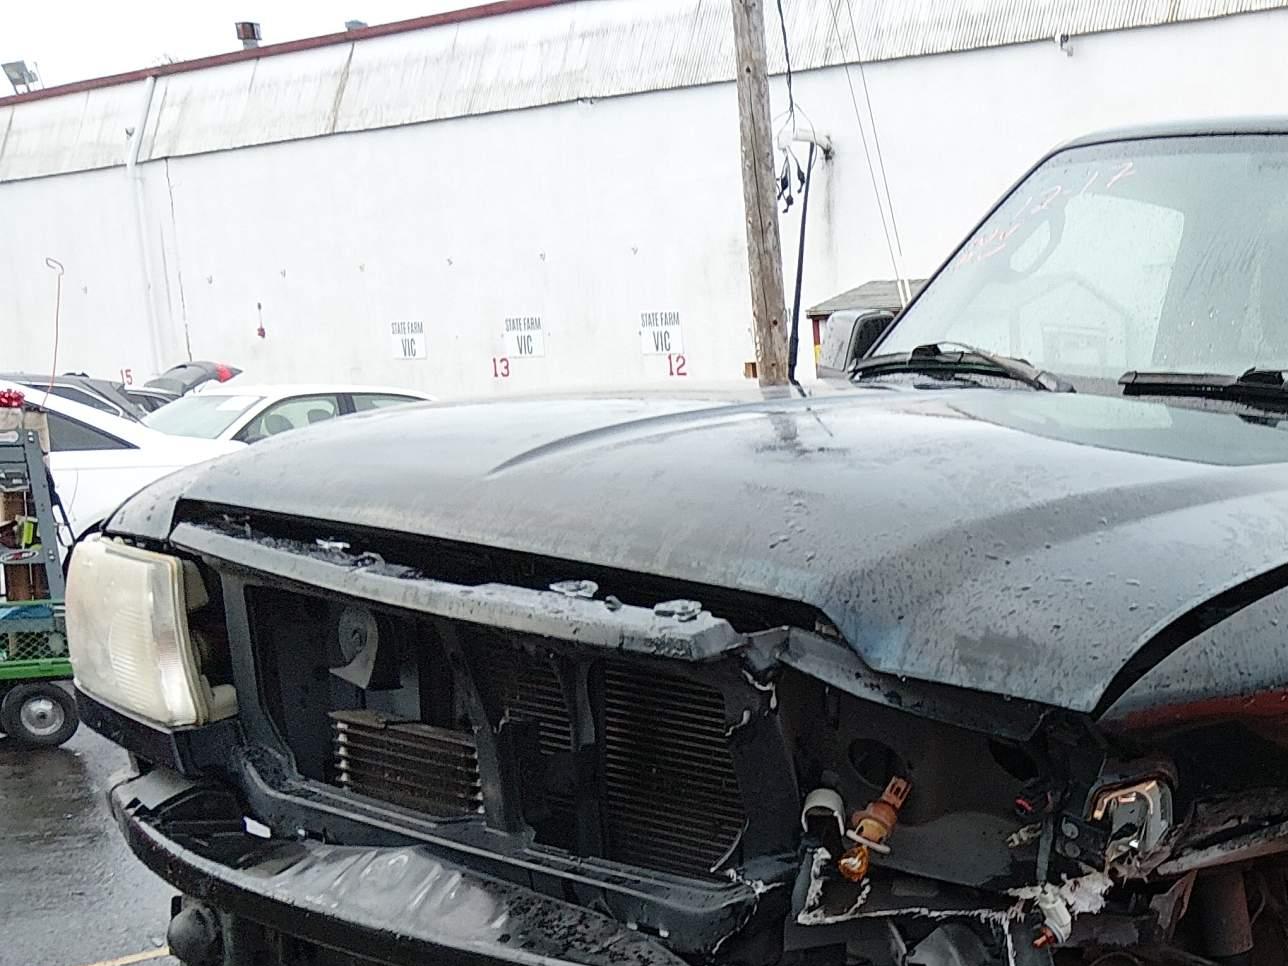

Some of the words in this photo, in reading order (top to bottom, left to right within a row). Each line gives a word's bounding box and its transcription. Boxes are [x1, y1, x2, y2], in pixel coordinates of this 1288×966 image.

[390, 322, 406, 335] STATE
[407, 320, 424, 334] FARM
[504, 318, 522, 332] STATE
[523, 316, 542, 331] FARM
[642, 312, 660, 328] STATE
[660, 311, 680, 327] FARM
[400, 337, 417, 357] VIC
[516, 334, 534, 355] VIC
[652, 330, 671, 352] VIC
[492, 357, 511, 378] 13
[668, 353, 688, 376] 12
[120, 368, 133, 385] 15
